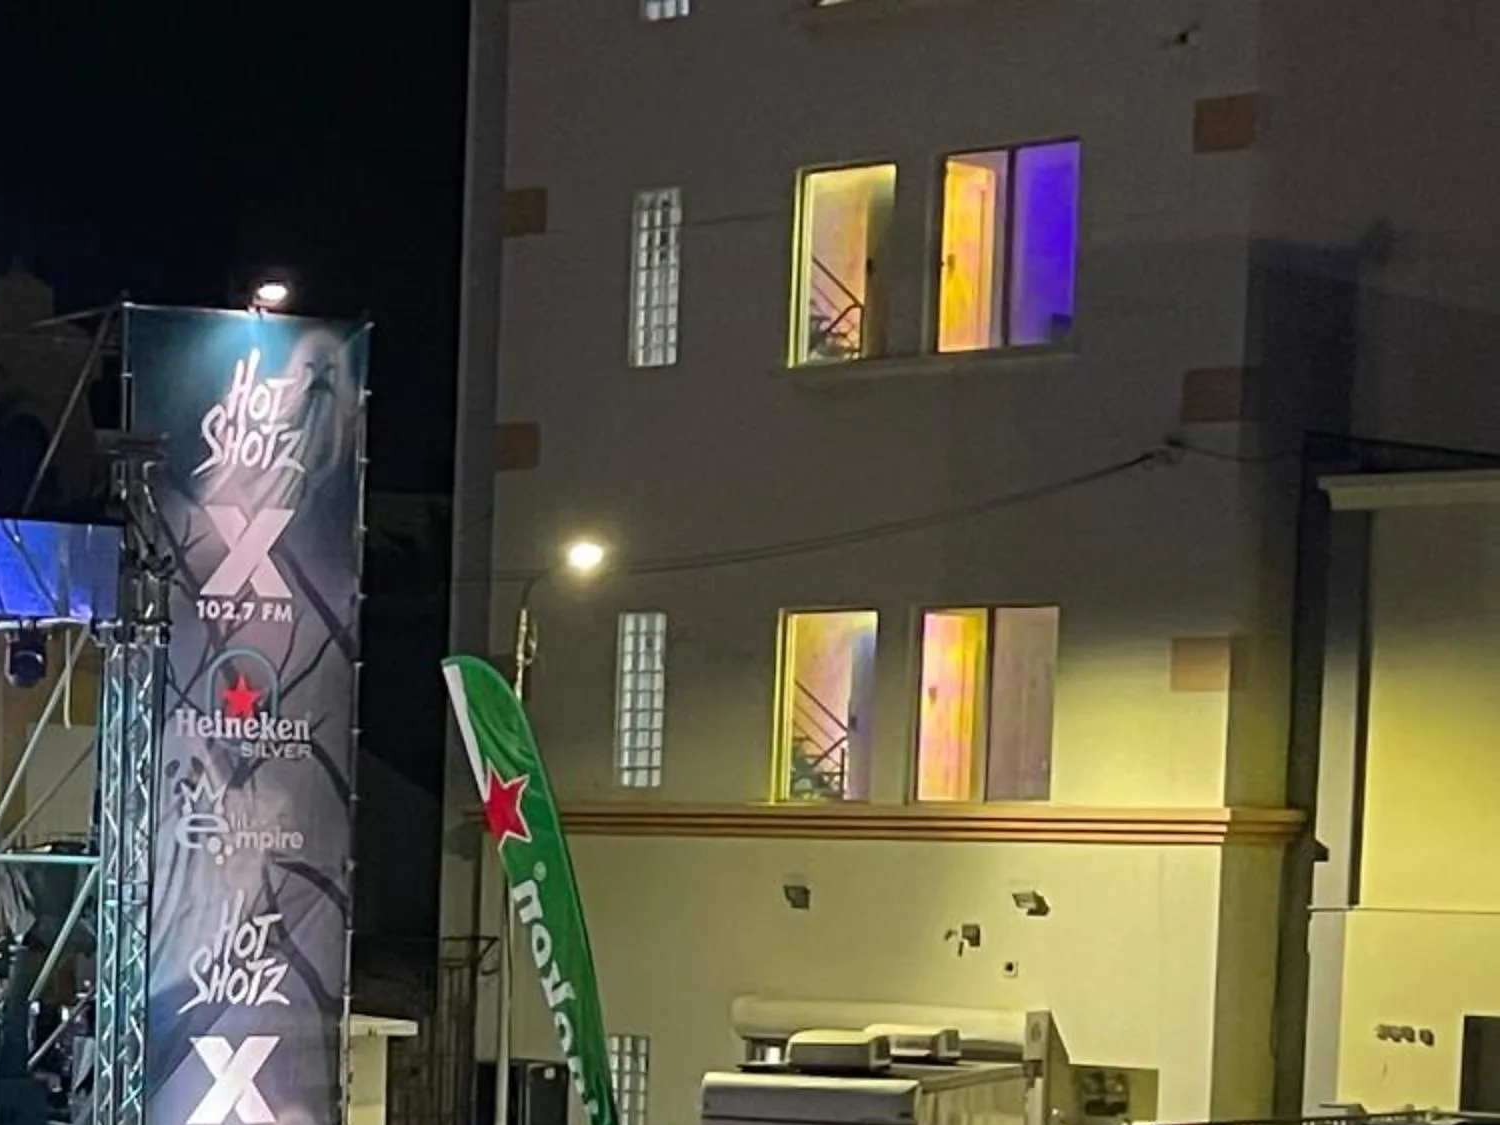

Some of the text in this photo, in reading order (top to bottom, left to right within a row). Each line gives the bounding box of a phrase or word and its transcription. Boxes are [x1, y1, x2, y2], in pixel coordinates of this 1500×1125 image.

[227, 348, 299, 424] HOT
[190, 403, 306, 476] SHOTZ
[200, 506, 295, 598] X
[196, 600, 293, 622] 102.7 FM
[175, 708, 311, 741] Heineken
[241, 742, 313, 759] SILVER
[213, 888, 283, 961] HOT
[177, 945, 291, 1015] SHOTZ
[186, 1035, 281, 1125] X
